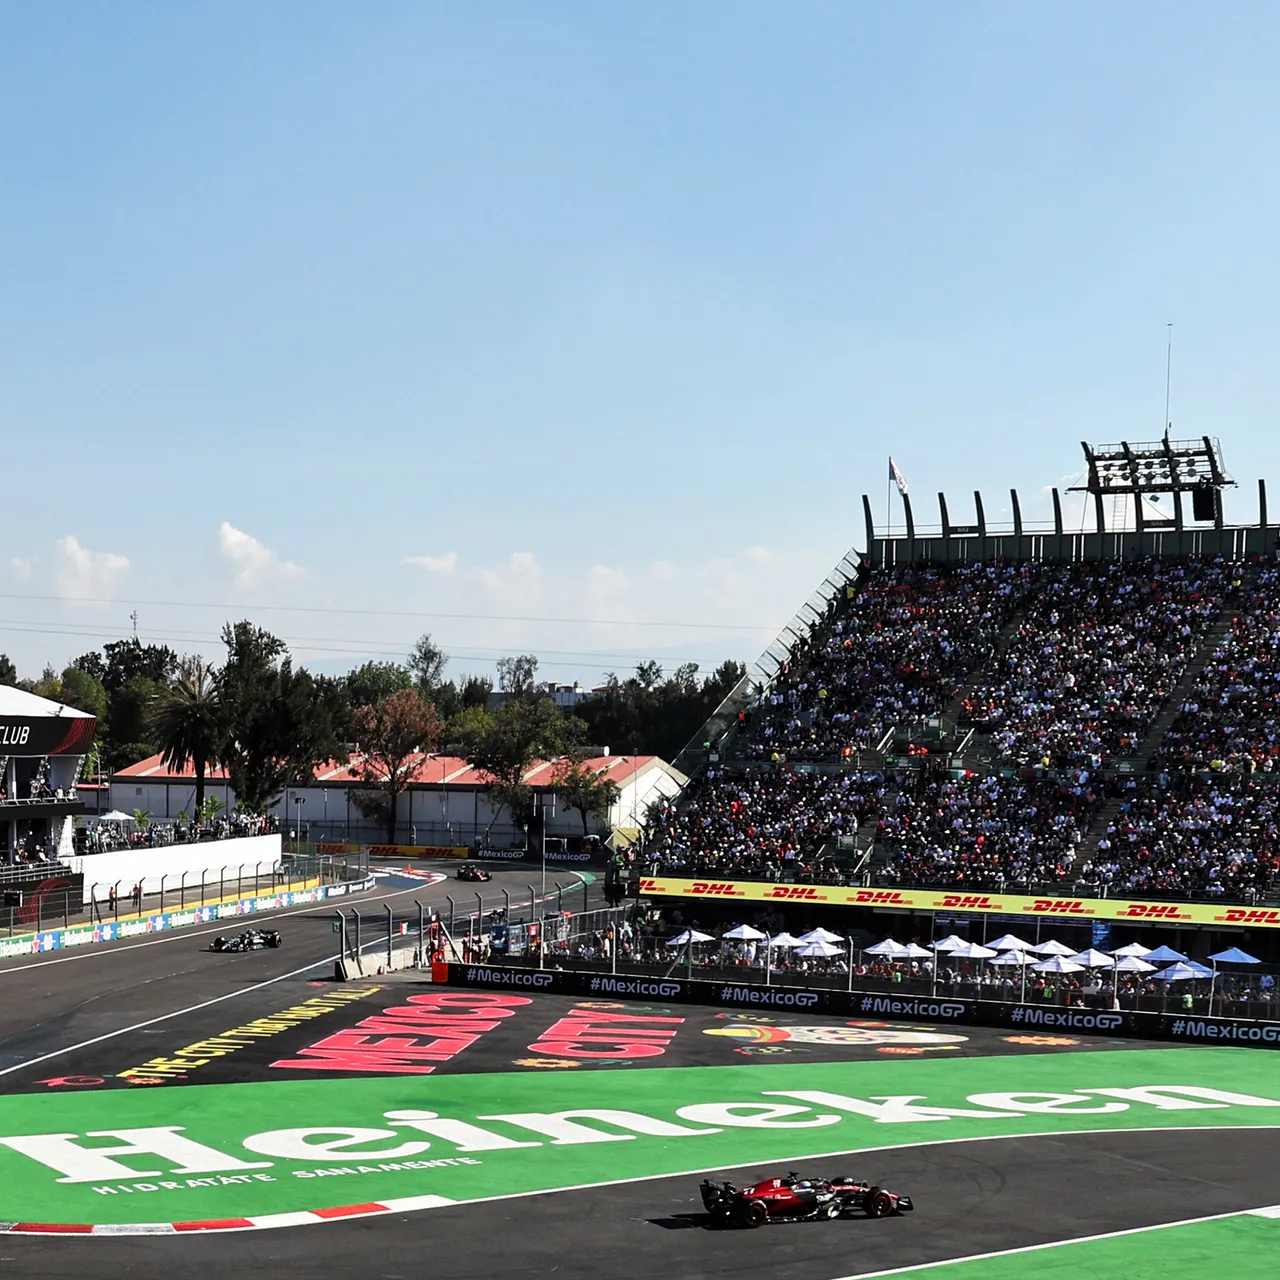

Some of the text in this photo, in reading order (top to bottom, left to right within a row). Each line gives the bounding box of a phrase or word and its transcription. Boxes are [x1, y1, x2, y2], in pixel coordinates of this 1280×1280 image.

[477, 849, 525, 860] #MexicoGP
[543, 853, 591, 862] #MexicoGP
[693, 883, 736, 895] DHL
[773, 887, 819, 899] DHL
[856, 891, 904, 904] DHL
[943, 895, 992, 908] DHL
[1033, 900, 1085, 913] DHL
[1127, 905, 1181, 918] DHL
[0, 938, 33, 957] Heineken
[466, 968, 554, 986] #MexicoGP
[590, 978, 681, 997] #MexicoGP
[721, 987, 819, 1007] #MexicoGP
[861, 998, 966, 1018] #MexicoGP
[1011, 1008, 1123, 1029] #MexicoGP
[268, 991, 686, 1075] MEXICO CITY
[116, 1056, 210, 1078] THE
[174, 1037, 255, 1058] CITY
[219, 1018, 302, 1037] THAT
[293, 1156, 483, 1180] SANAMENTE
